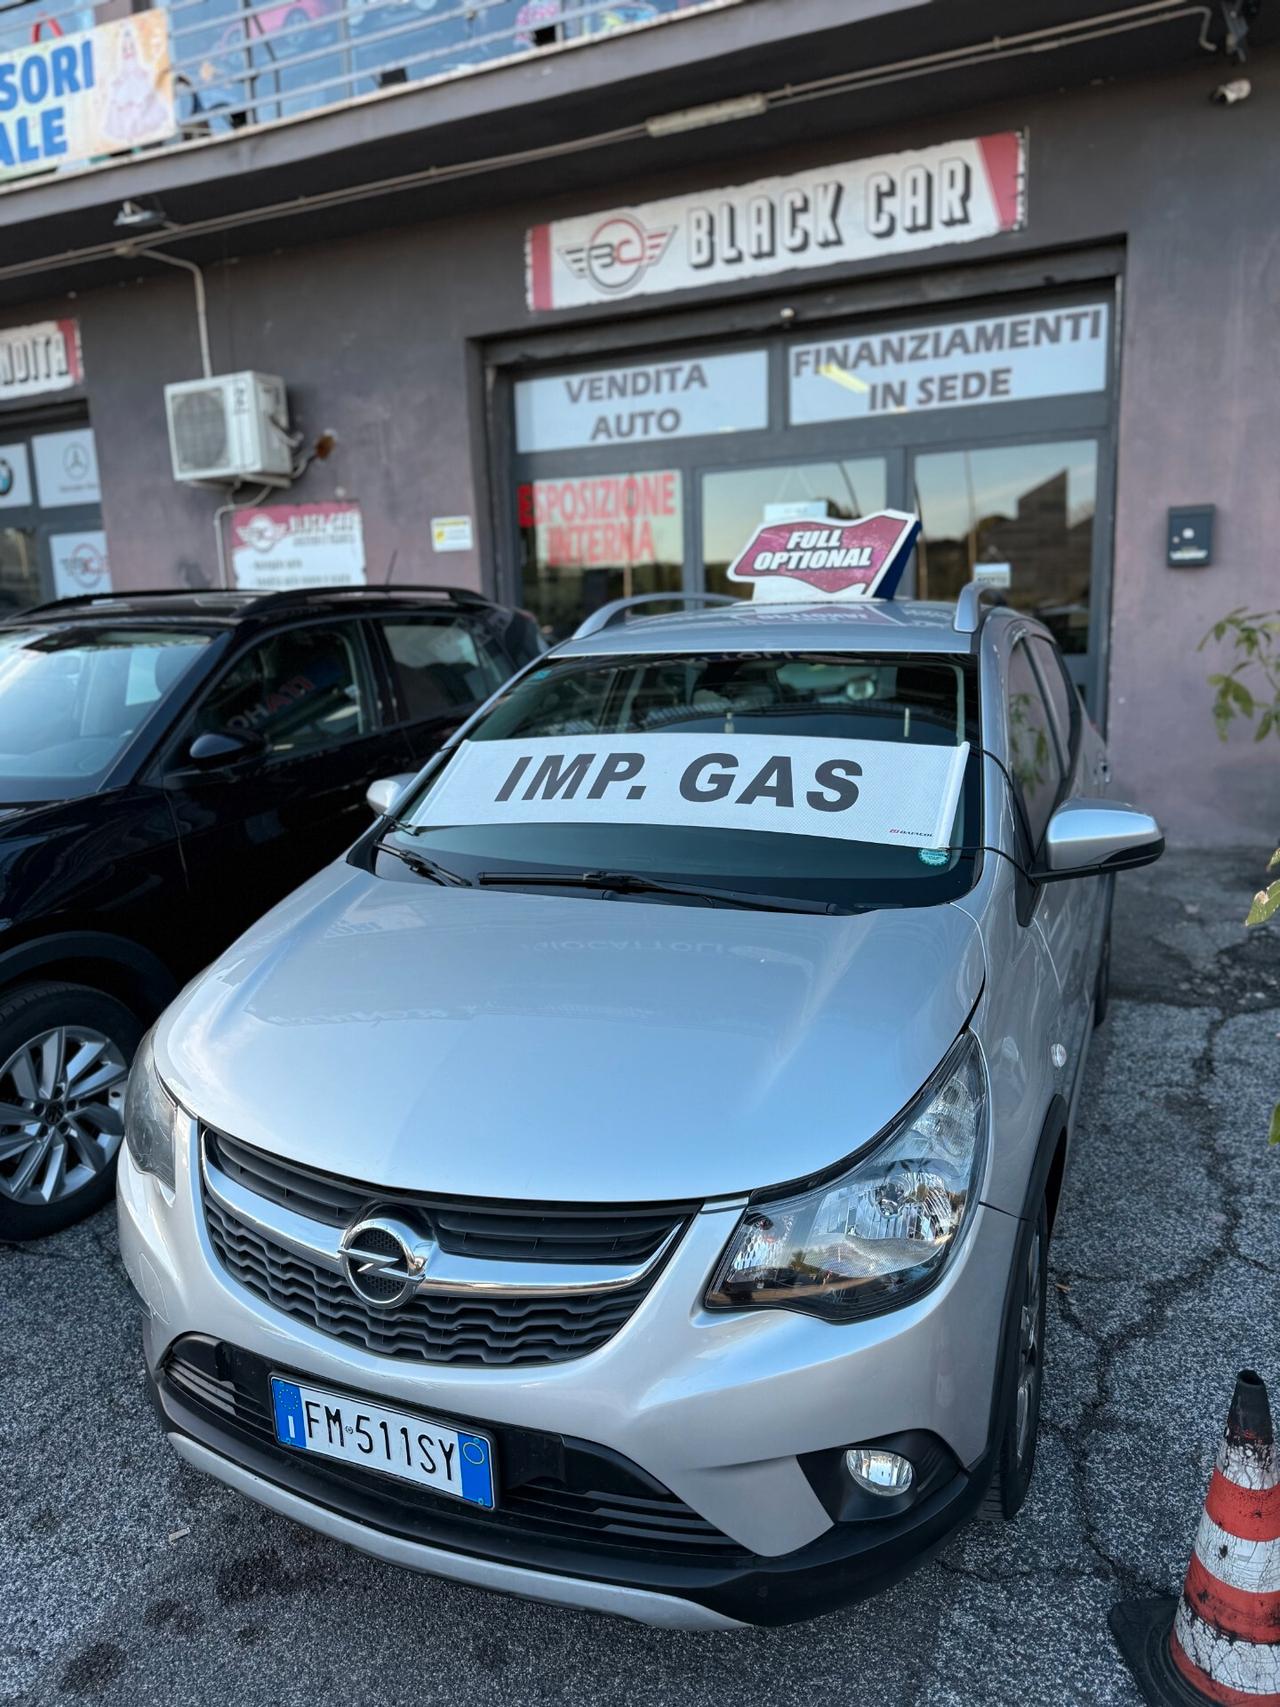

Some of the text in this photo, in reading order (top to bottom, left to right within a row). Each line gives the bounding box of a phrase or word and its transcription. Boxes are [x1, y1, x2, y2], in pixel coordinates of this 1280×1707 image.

[0, 40, 95, 112] SORI
[687, 155, 972, 270] BLACK CAR
[793, 309, 1103, 377] FINANZIAMENTI
[564, 363, 708, 405] VENDITA
[867, 367, 1013, 412] IN SEDE
[590, 407, 683, 442] AUTO
[517, 472, 677, 529] ESPOSIZIONE
[547, 519, 657, 567] INTERNA
[752, 546, 873, 572] OPTIONAL
[786, 528, 844, 551] FULL
[493, 752, 864, 813] IMP. GAS
